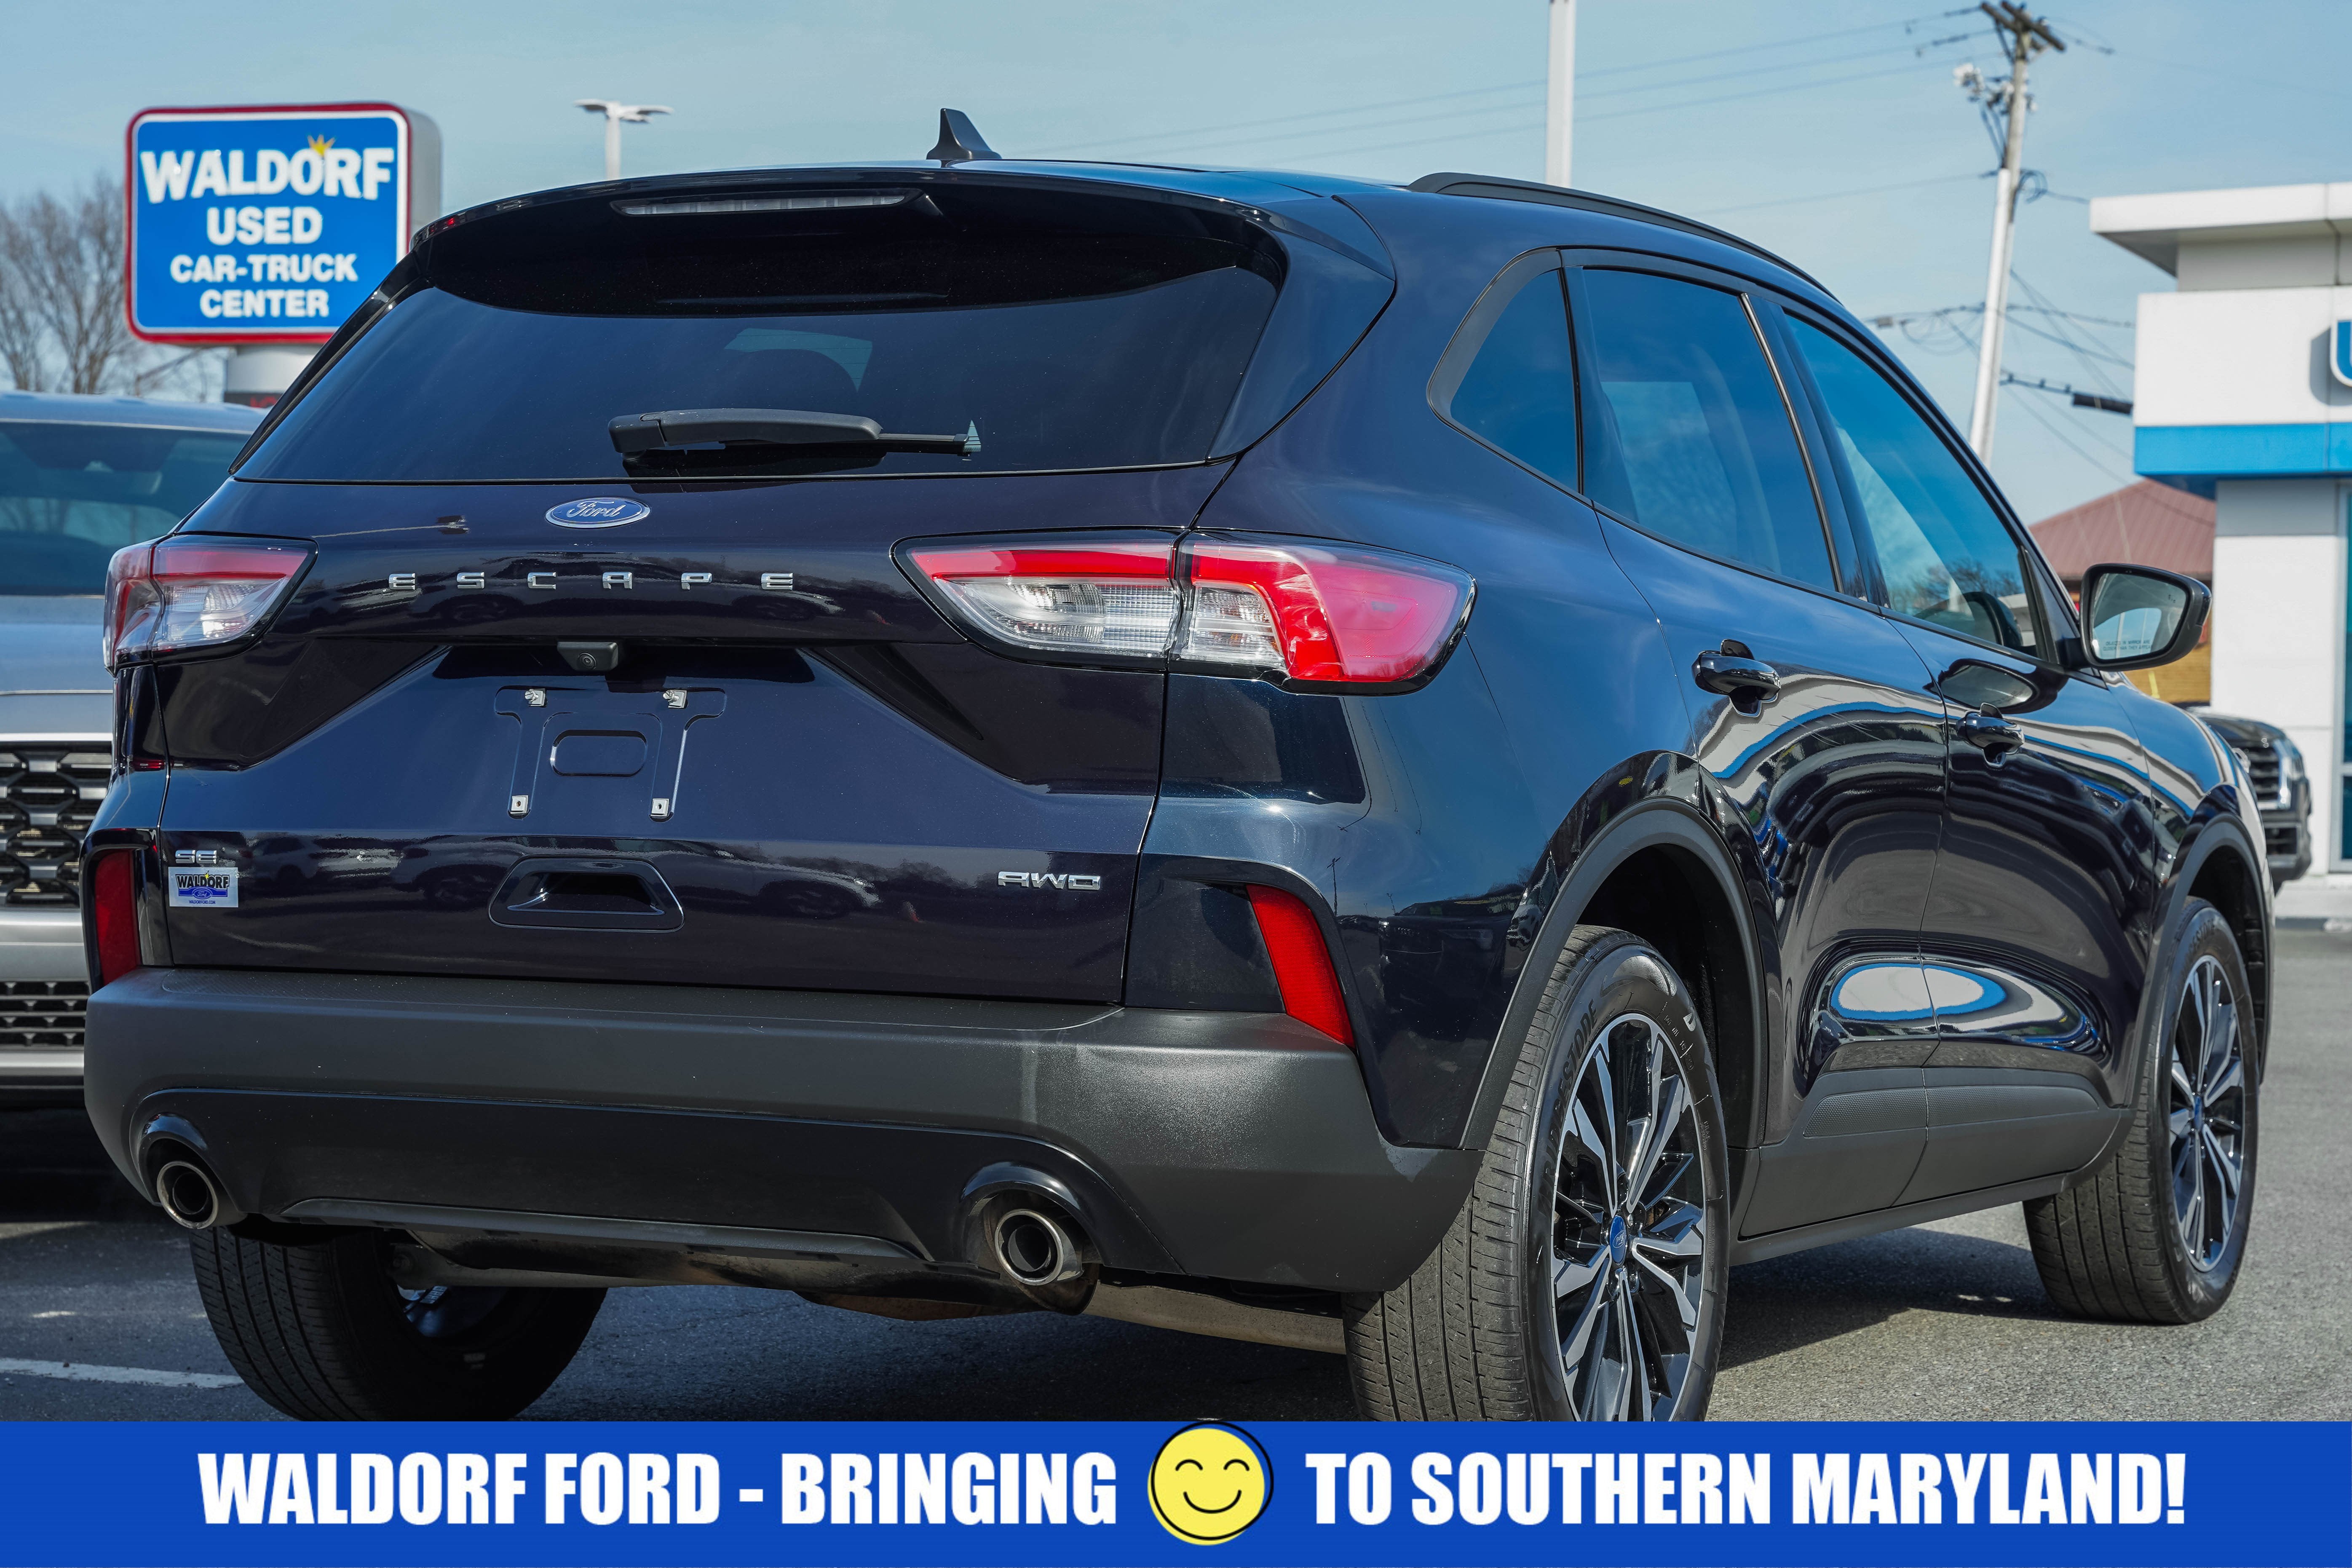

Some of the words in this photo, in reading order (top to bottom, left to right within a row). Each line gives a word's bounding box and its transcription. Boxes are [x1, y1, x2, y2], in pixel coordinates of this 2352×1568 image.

[140, 147, 394, 204] WALDORF
[206, 206, 323, 246] USED
[170, 253, 359, 284] CAR-TRUCK
[199, 289, 329, 318] CENTER
[566, 500, 626, 518] Ford
[388, 572, 793, 591] ESCAPE
[175, 850, 217, 864] SE
[176, 875, 229, 888] WALDORF
[998, 871, 1101, 891] AWD
